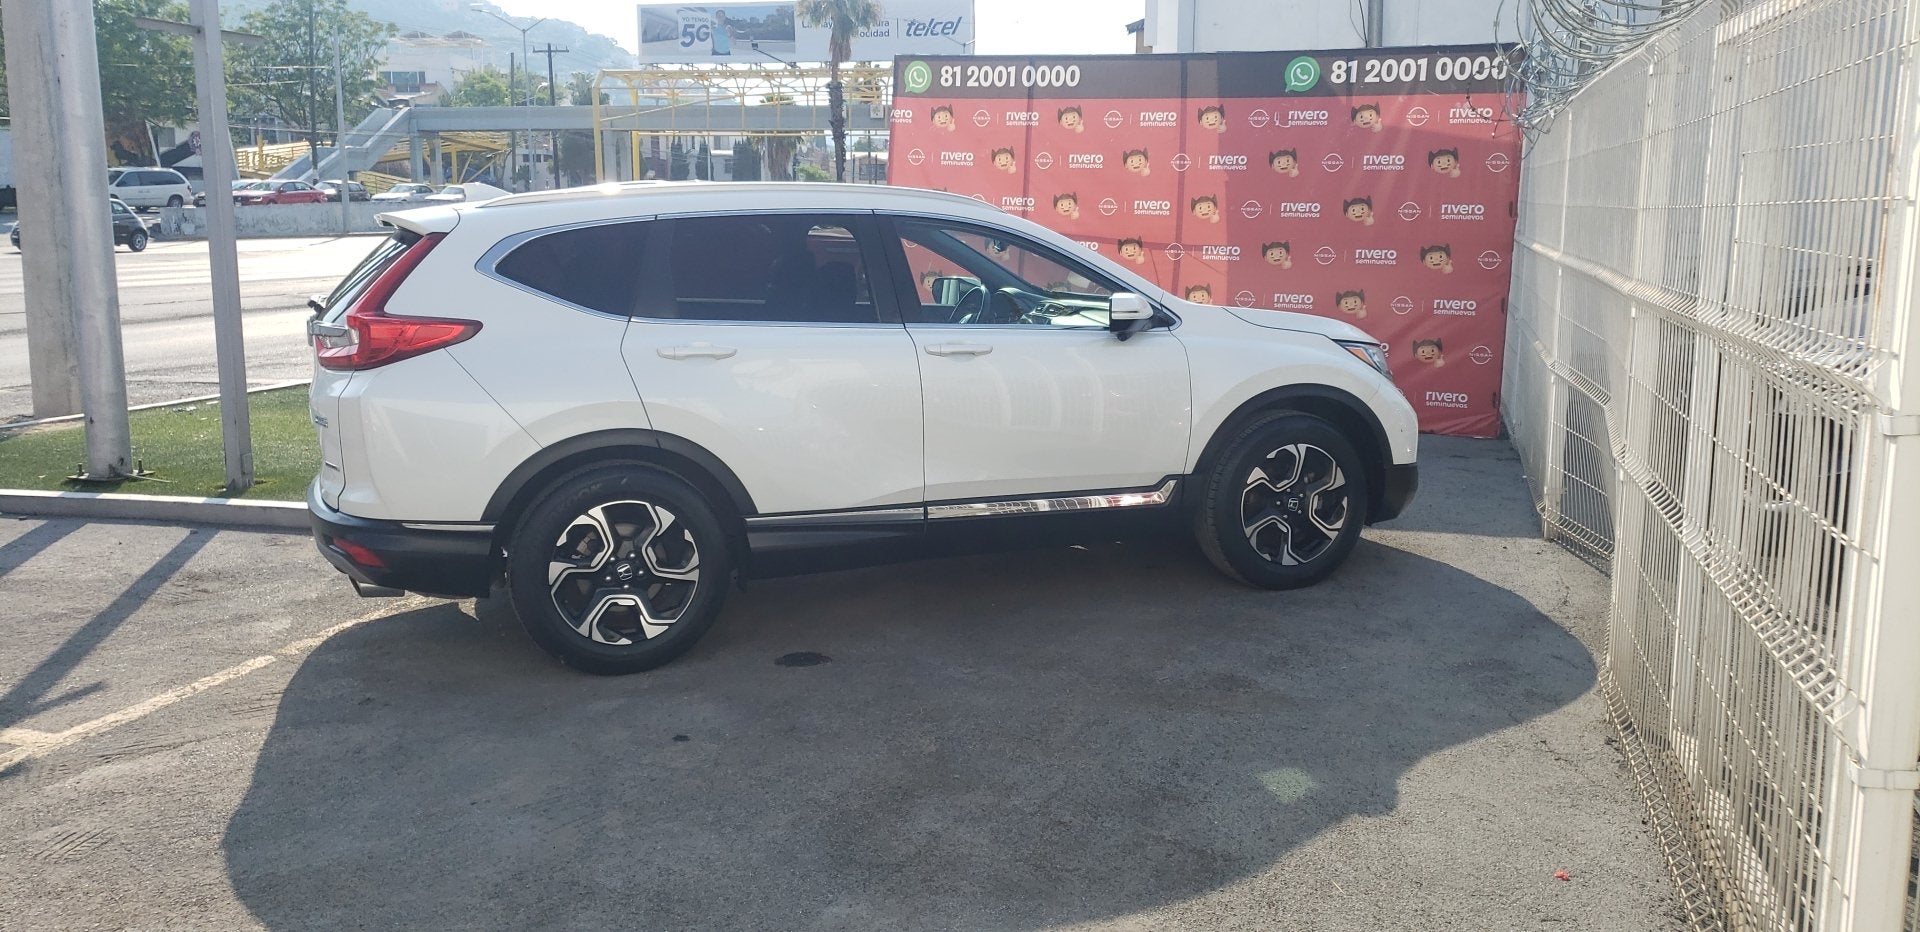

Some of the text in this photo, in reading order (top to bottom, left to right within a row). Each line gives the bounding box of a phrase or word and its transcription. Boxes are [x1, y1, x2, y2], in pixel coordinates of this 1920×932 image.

[906, 16, 962, 37] telcel
[680, 24, 710, 47] 5G
[1331, 56, 1508, 84] 81 2001 0000
[941, 65, 1080, 88] 81 2001 0000
[1006, 111, 1039, 121] rivero
[1140, 111, 1177, 122] rivero
[1288, 110, 1328, 120] rivero
[1449, 106, 1493, 117] rivero
[941, 151, 974, 161] rivero
[1069, 153, 1103, 163] rivero
[1209, 155, 1247, 165] rivero
[1363, 154, 1405, 165] rivero
[1002, 196, 1035, 206] rivero
[1134, 199, 1170, 210] rivero
[1134, 208, 1170, 216] seminuevos
[1280, 202, 1321, 212] rivero
[1441, 203, 1485, 215] rivero
[1280, 211, 1321, 219] seminuevos
[1441, 213, 1485, 221] seminuevos
[1203, 244, 1241, 255] rivero
[1356, 248, 1397, 259] rivero
[1274, 293, 1314, 304] rivero
[1274, 302, 1314, 310] seminuevos
[1433, 299, 1477, 310] rivero
[1433, 308, 1477, 316] seminuevos
[1426, 391, 1468, 403] rivero
[1426, 401, 1468, 409] seminuevos
